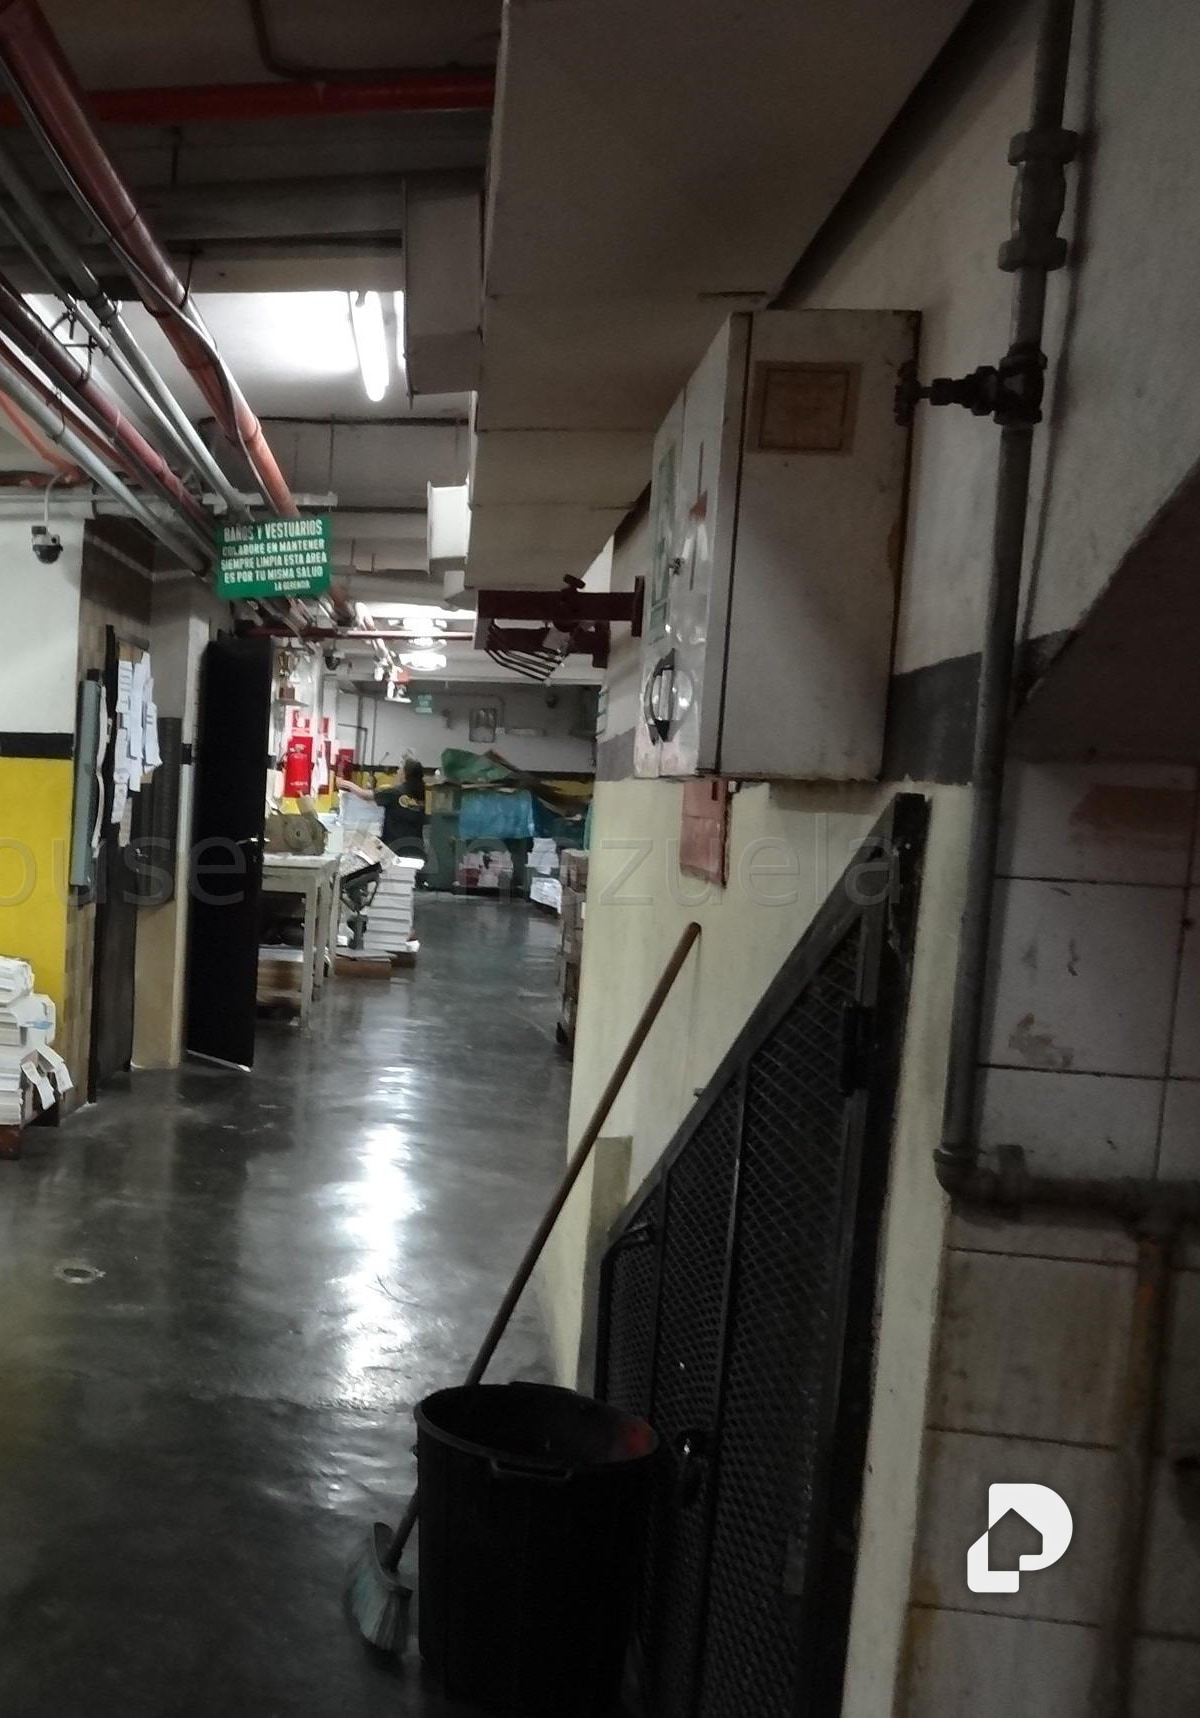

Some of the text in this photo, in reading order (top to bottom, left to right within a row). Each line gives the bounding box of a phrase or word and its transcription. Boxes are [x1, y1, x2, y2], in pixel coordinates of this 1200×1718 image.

[223, 519, 323, 543] BAÑOS Y VESTUARIOS
[222, 538, 325, 556] COLABORE EN MANTENER
[220, 551, 328, 571] SIEMPRE LIMPIA ESTA AREA
[224, 565, 323, 584] ES POR TU MISMA SALUD
